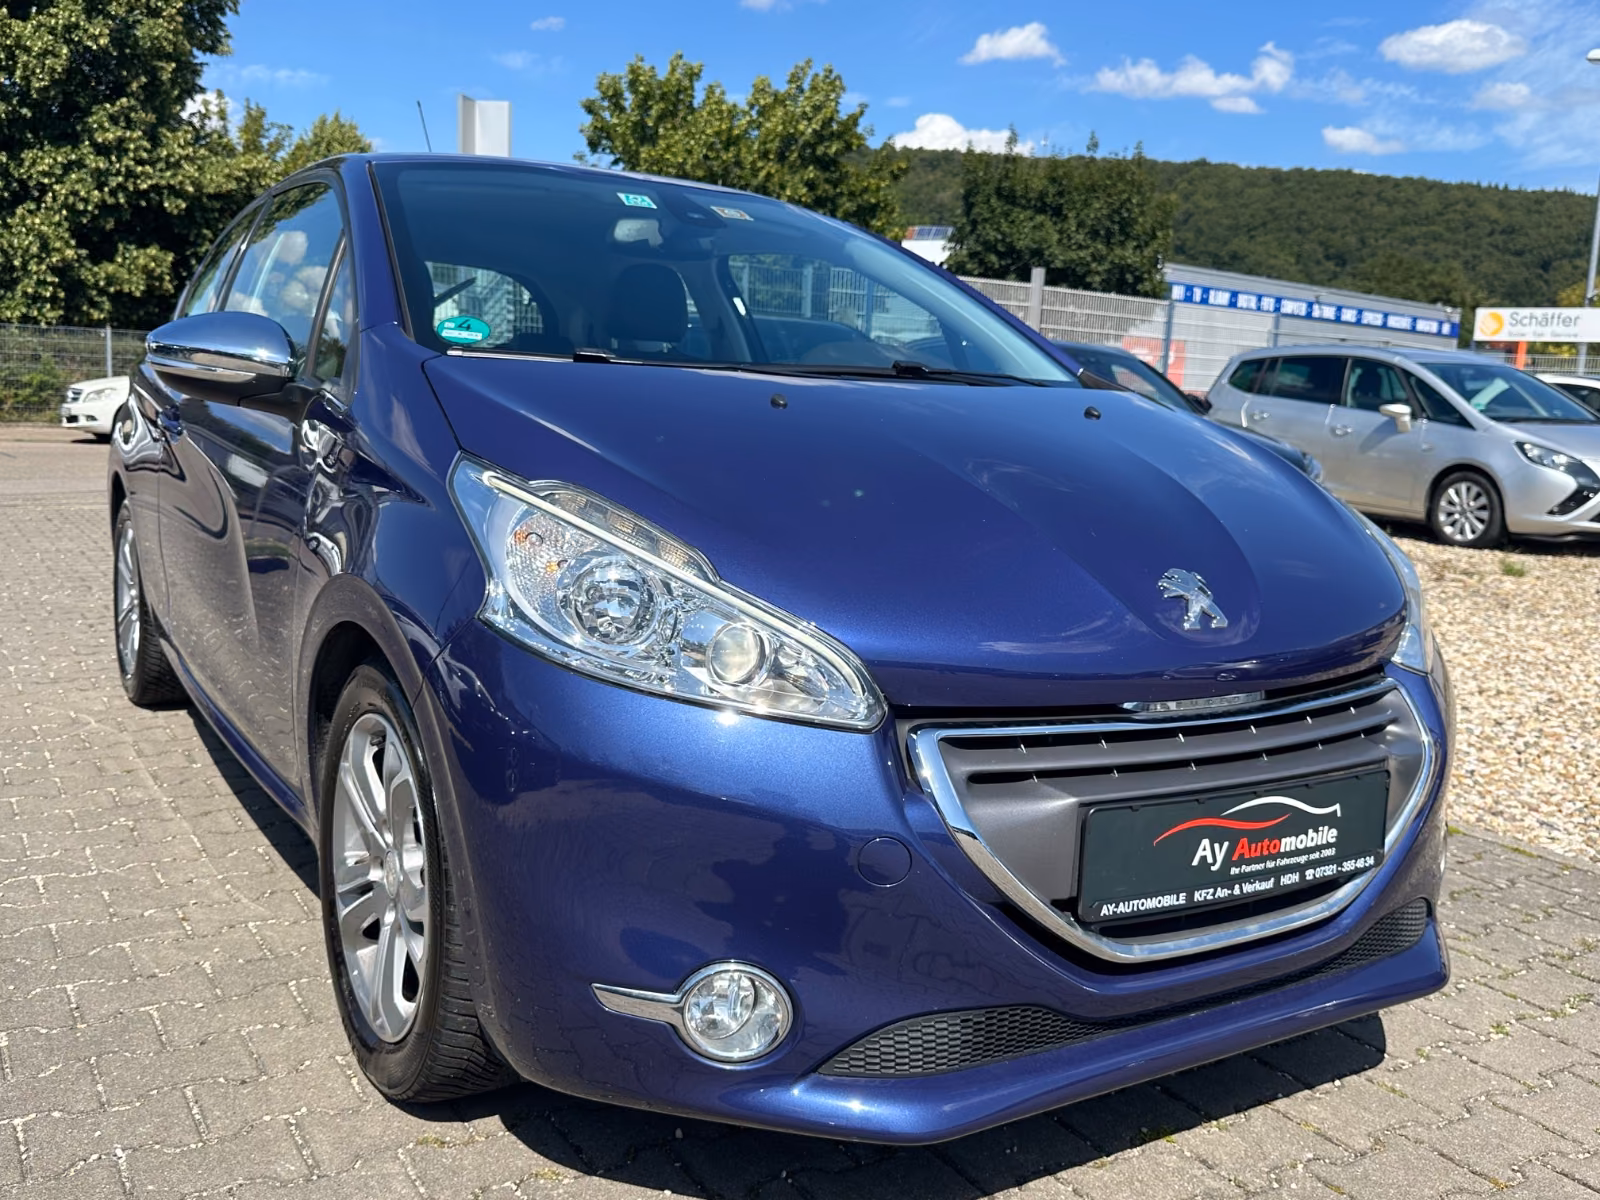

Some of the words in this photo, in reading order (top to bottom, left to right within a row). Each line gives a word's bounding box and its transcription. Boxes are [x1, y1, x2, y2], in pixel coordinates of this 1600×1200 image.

[458, 319, 471, 331] 4
[1509, 311, 1580, 328] Schäffer
[1192, 838, 1229, 871] Ay
[1232, 826, 1338, 861] Automobile
[1230, 866, 1240, 875] Ihr
[1241, 862, 1265, 873] Partner
[1266, 859, 1276, 869] für
[1276, 854, 1309, 867] Fahrzeuge
[1309, 851, 1320, 860] seit
[1320, 848, 1336, 858] 2003
[1100, 893, 1186, 916] AY-AUTOMOBILE
[1194, 888, 1214, 901] KFZ
[1215, 887, 1231, 898] An-
[1233, 884, 1240, 895] &
[1242, 877, 1274, 893] Verkauf
[1280, 872, 1299, 886] HDH
